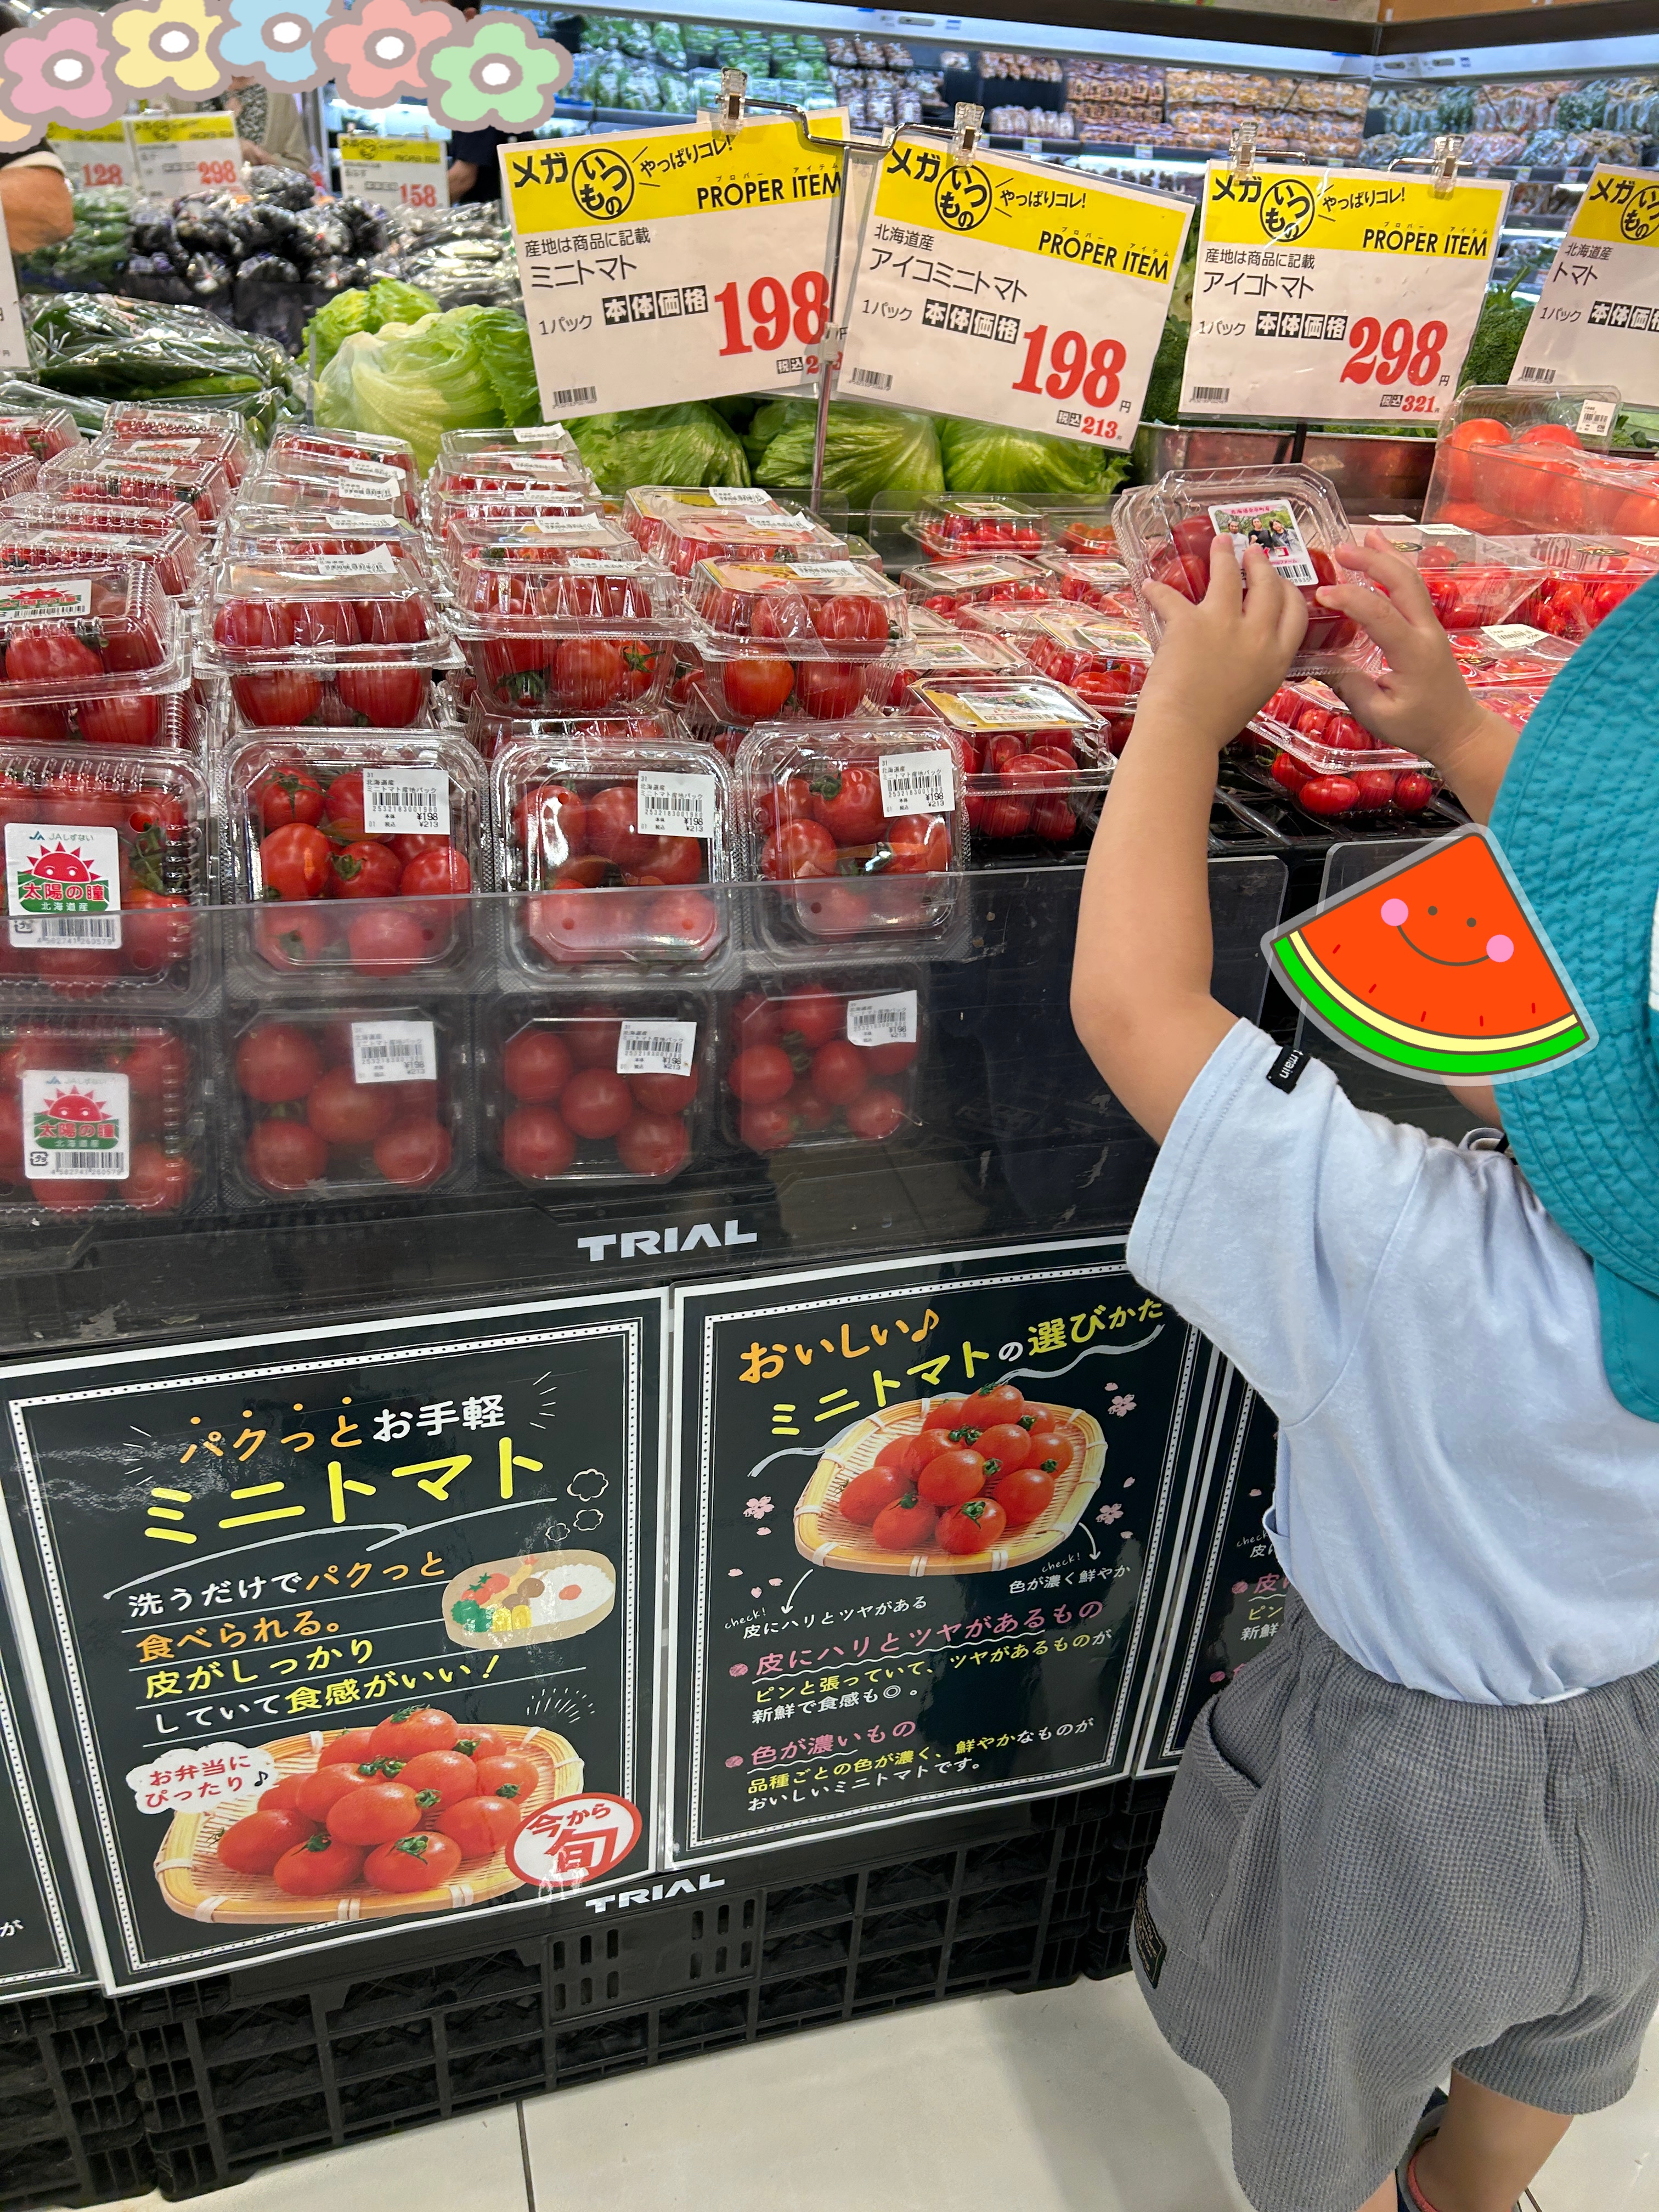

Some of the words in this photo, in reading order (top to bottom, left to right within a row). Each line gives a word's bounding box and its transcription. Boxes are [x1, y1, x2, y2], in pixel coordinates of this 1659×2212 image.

[512, 151, 568, 188] メガ
[886, 147, 941, 183] メガ
[400, 184, 437, 207] 158
[697, 178, 784, 210] PROPER
[792, 171, 841, 198] ITEM
[1211, 176, 1261, 203] メガ
[1589, 178, 1635, 205] メガ
[524, 227, 651, 258] 産地は商品に記載
[874, 223, 934, 252] 北海道産
[1362, 228, 1437, 254] PROPER
[1443, 232, 1487, 257] ITEM
[1565, 241, 1614, 261] 北海道産
[1038, 230, 1118, 268] PROPER
[1122, 249, 1169, 281] ITEM
[1204, 247, 1316, 270] 産地は商品に記載
[530, 254, 637, 289] ミニトマト
[869, 248, 1028, 303] アイコミニトマト
[1203, 270, 1314, 300] アイコトマト
[1553, 261, 1598, 286] トマト
[602, 285, 709, 326] 本体価格
[714, 270, 830, 357] 198
[862, 298, 913, 321] 1パック
[1539, 306, 1582, 323] 1パック
[538, 314, 593, 336] 1パック
[922, 298, 1021, 345] 本体価格
[1198, 319, 1245, 336] 1パック
[1255, 310, 1349, 341] 本体価格
[777, 357, 804, 374] 税込
[1339, 316, 1448, 387] 298
[1438, 374, 1450, 387] 円
[1012, 324, 1127, 408] 198
[1119, 400, 1132, 413] 円
[1401, 394, 1435, 413] 321
[1081, 416, 1119, 439] 213
[926, 792, 944, 801] ¥198
[416, 812, 438, 821] ¥198
[684, 817, 703, 826] ¥198
[22, 882, 105, 902] 太陽の瞳
[41, 902, 89, 912] 北海道産
[663, 1057, 681, 1065] ¥198
[577, 1219, 758, 1262] TRIAL
[771, 1297, 1164, 1435] ミニトマトの選びかた
[180, 1395, 506, 1463] パクっとお手軽
[144, 1437, 544, 1544] ミニトマト
[1042, 1553, 1080, 1572] check!
[128, 1551, 445, 1617] 洗うだけでパクっと
[1009, 1565, 1131, 1594] 色が濃く鮮やか
[725, 1607, 766, 1629] check!
[743, 1595, 927, 1640] 皮にハリとツヤがある
[1240, 1622, 1279, 1641] 新鮮
[136, 1611, 340, 1663] 食べられる。
[756, 1600, 1103, 1676] 皮にハリとツヤがあるもの
[146, 1639, 372, 1700] 皮がしっかり
[156, 1655, 499, 1735] していて食感がいい!
[751, 1721, 916, 1764] 色が濃いもの
[149, 1756, 251, 1787] お弁当に
[748, 1757, 980, 1811] おいしいミニトマトです。
[527, 1804, 611, 1837] 今から
[544, 1827, 619, 1878] 旬
[585, 1874, 725, 1914] TRIAL
